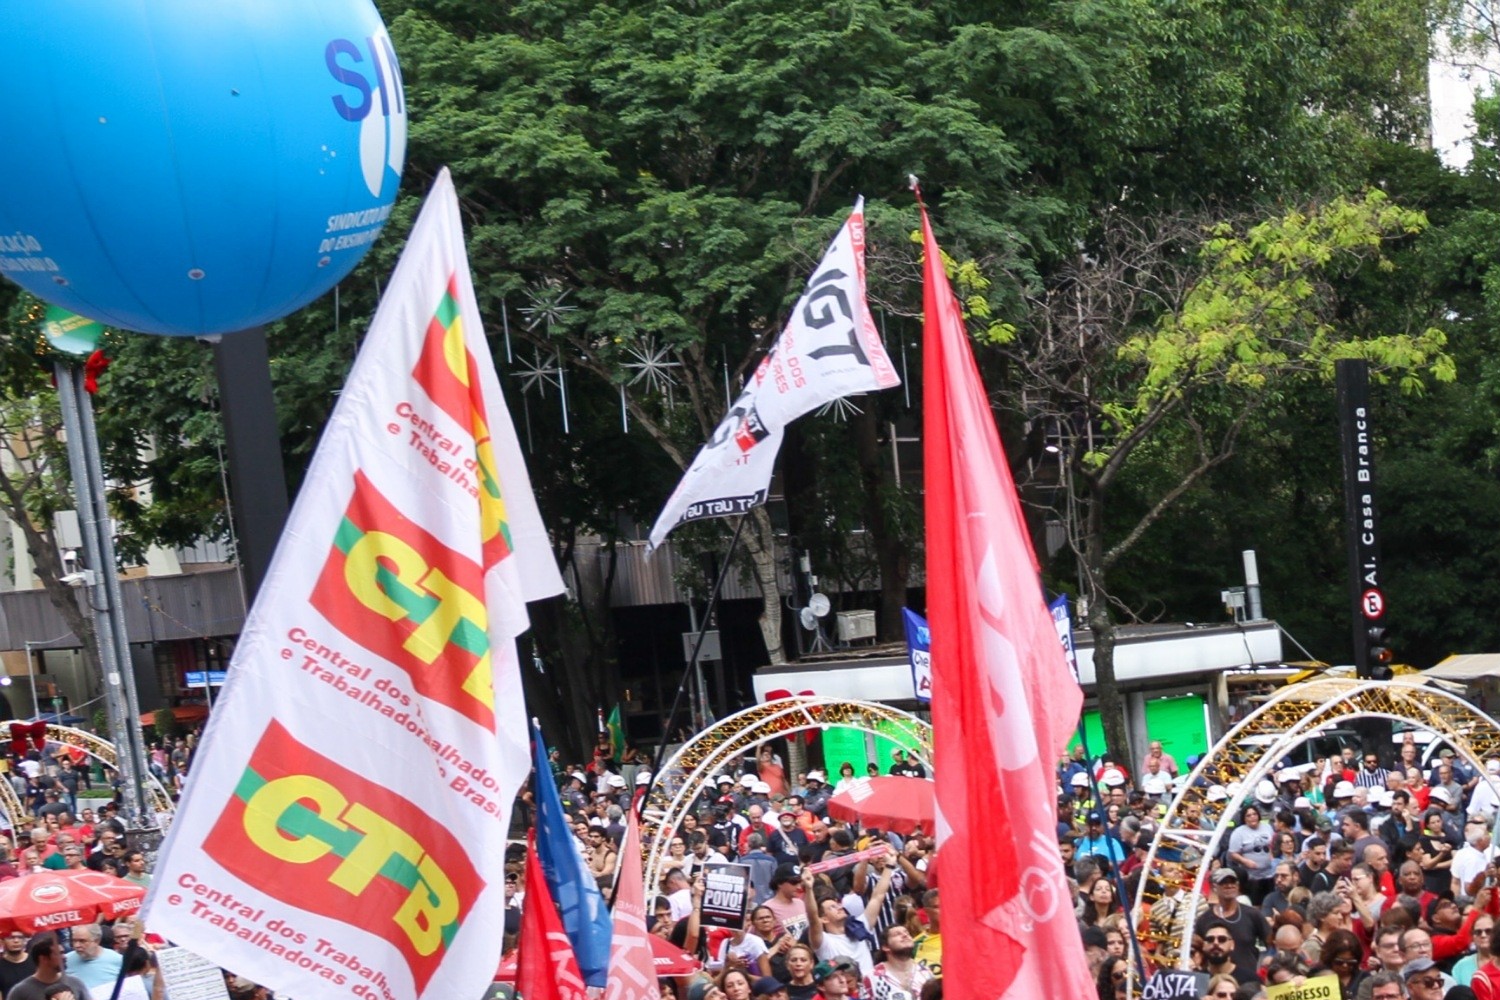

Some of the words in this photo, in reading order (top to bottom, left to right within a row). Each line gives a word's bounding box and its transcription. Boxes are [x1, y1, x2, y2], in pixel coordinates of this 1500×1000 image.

[386, 421, 402, 436] e
[395, 401, 462, 456] Central
[1355, 407, 1371, 482] Branca
[1361, 494, 1375, 545] Casa
[280, 647, 294, 661] e
[287, 626, 372, 681] Central
[373, 677, 412, 708] dos
[242, 774, 460, 957] CTB
[33, 910, 83, 928] AMSTEL
[178, 872, 265, 923] Central
[266, 917, 309, 947] dos
[703, 889, 744, 909] POVO!
[167, 892, 183, 907] e
[188, 900, 349, 987] Trabalhadoras
